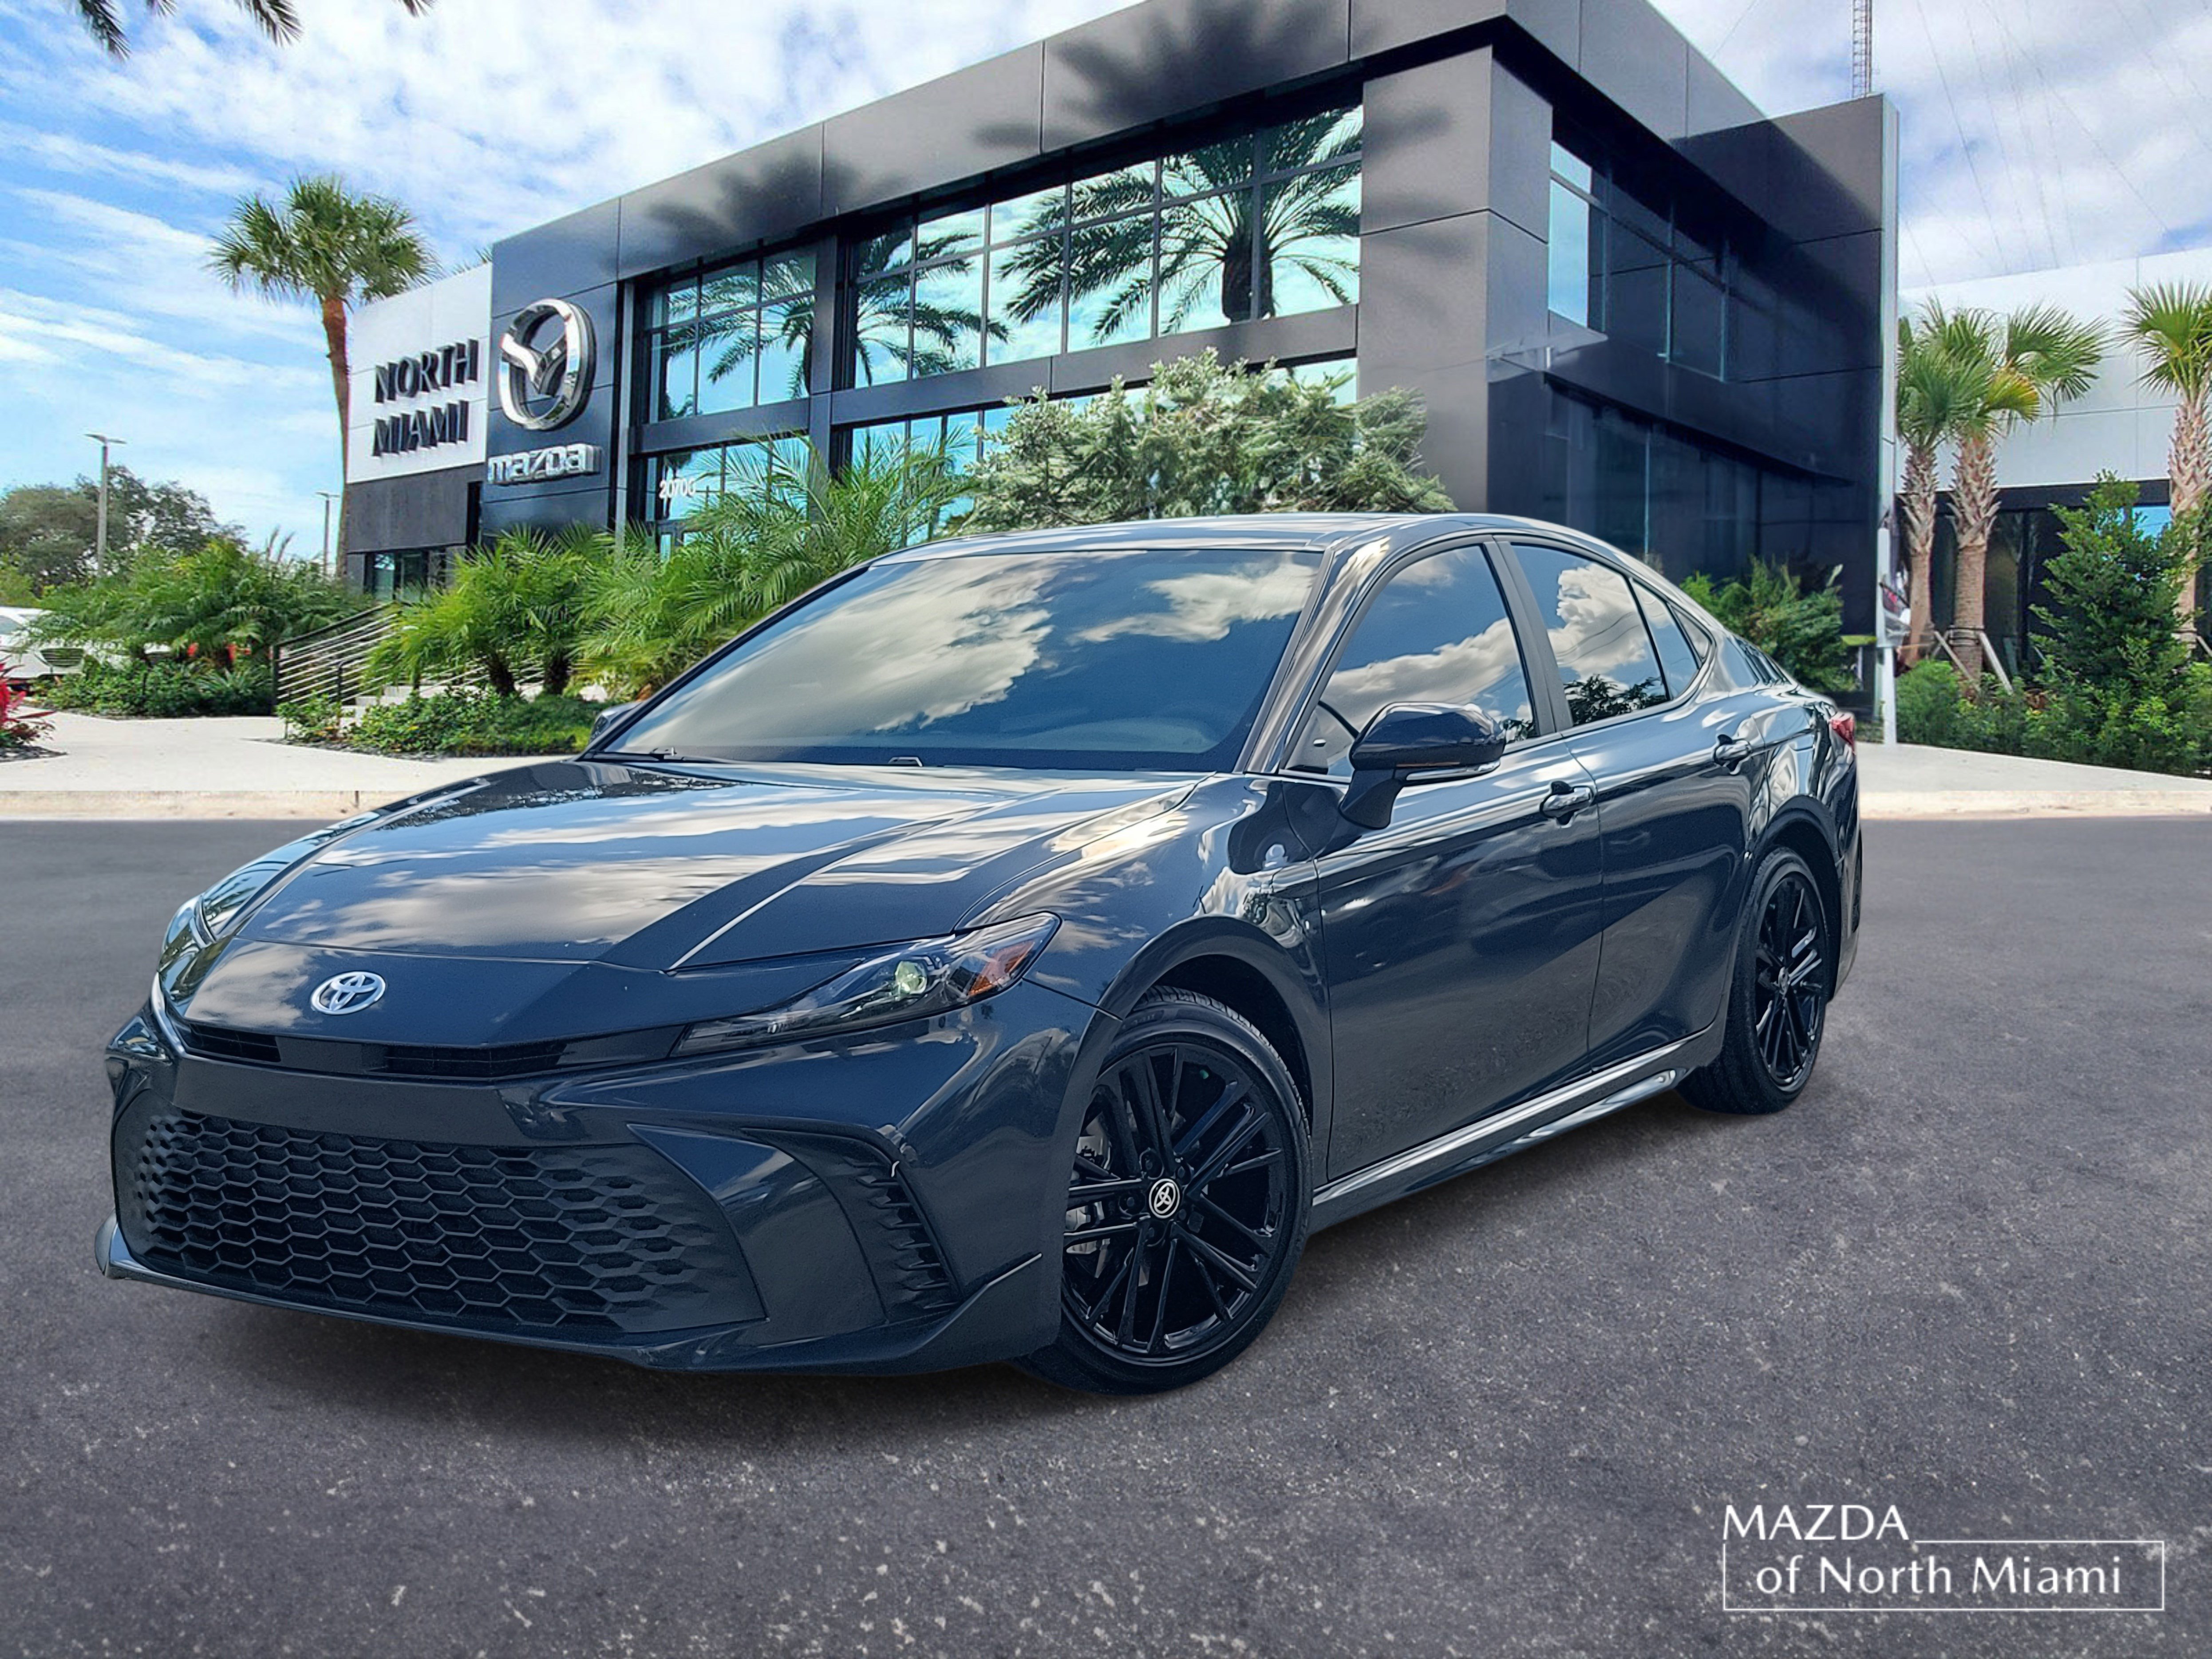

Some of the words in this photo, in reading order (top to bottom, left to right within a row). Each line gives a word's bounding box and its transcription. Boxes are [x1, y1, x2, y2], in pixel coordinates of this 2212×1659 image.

[375, 338, 479, 404] NORTH
[372, 400, 469, 457] MIAMI
[487, 442, 595, 486] mazda
